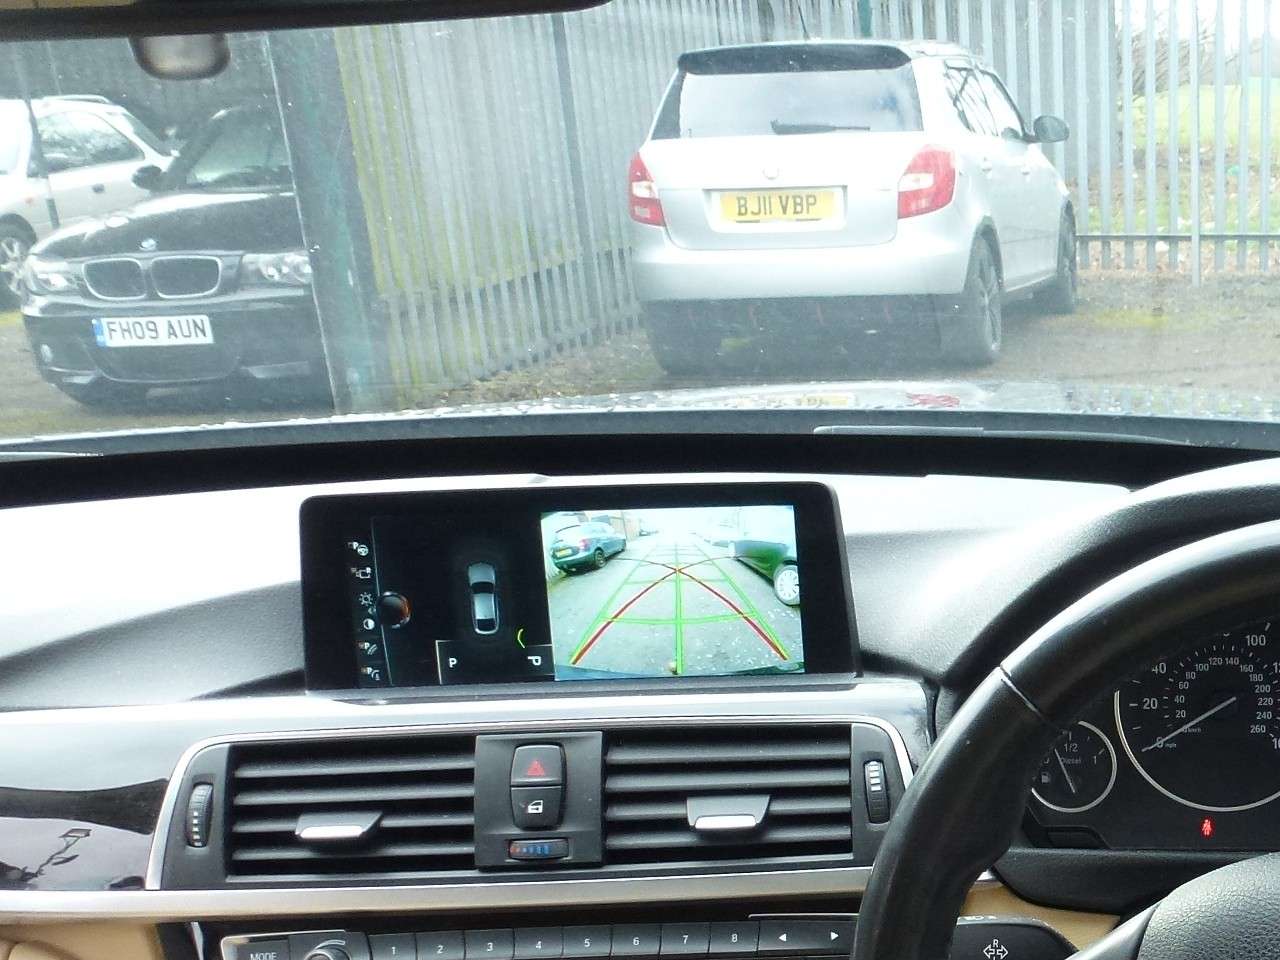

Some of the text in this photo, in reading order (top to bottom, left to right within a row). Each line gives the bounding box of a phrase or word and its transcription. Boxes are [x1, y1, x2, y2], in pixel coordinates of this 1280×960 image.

[736, 194, 818, 217] BJ11 VBP
[106, 318, 208, 341] FH09 AUN
[1245, 634, 1267, 647] 100
[449, 657, 457, 668] P
[1208, 657, 1223, 666] 120
[1224, 657, 1240, 666] 140
[1194, 663, 1210, 672] 100
[1254, 684, 1271, 693] 200
[1142, 697, 1159, 710] 20
[1174, 695, 1185, 704] 40
[1257, 697, 1274, 706] 220
[1175, 709, 1187, 719] 20
[1256, 711, 1273, 720] 240
[1250, 724, 1266, 734] 260
[632, 937, 640, 946] 6
[682, 935, 689, 944] 7
[731, 933, 738, 943] 8
[486, 942, 494, 952] 3
[535, 940, 542, 950] 4
[584, 938, 591, 948] 5
[992, 939, 999, 948] R
[391, 946, 397, 955] 1
[436, 945, 444, 954] 2
